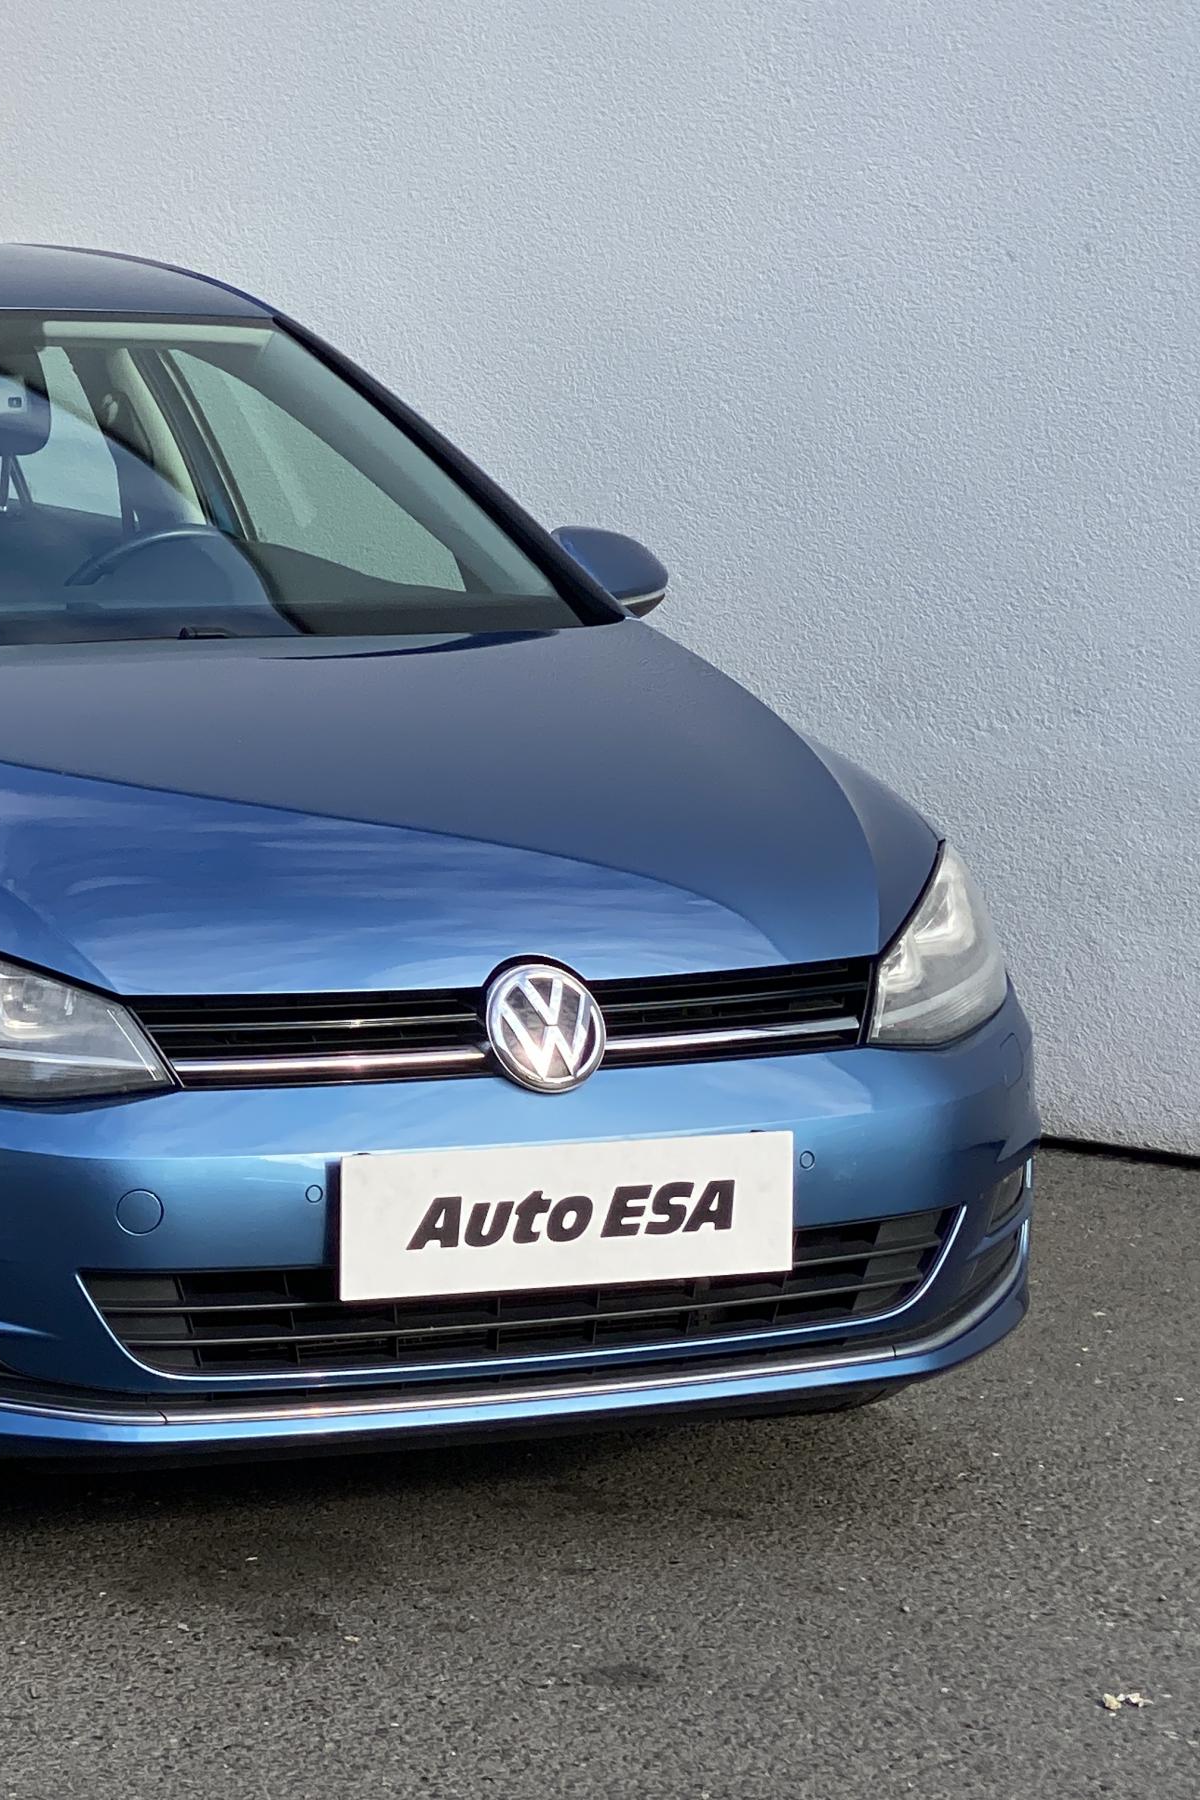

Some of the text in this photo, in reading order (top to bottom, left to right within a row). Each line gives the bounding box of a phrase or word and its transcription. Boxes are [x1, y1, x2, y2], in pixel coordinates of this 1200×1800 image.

[496, 970, 596, 1082] VW
[406, 1179, 735, 1251] Auto ESA
